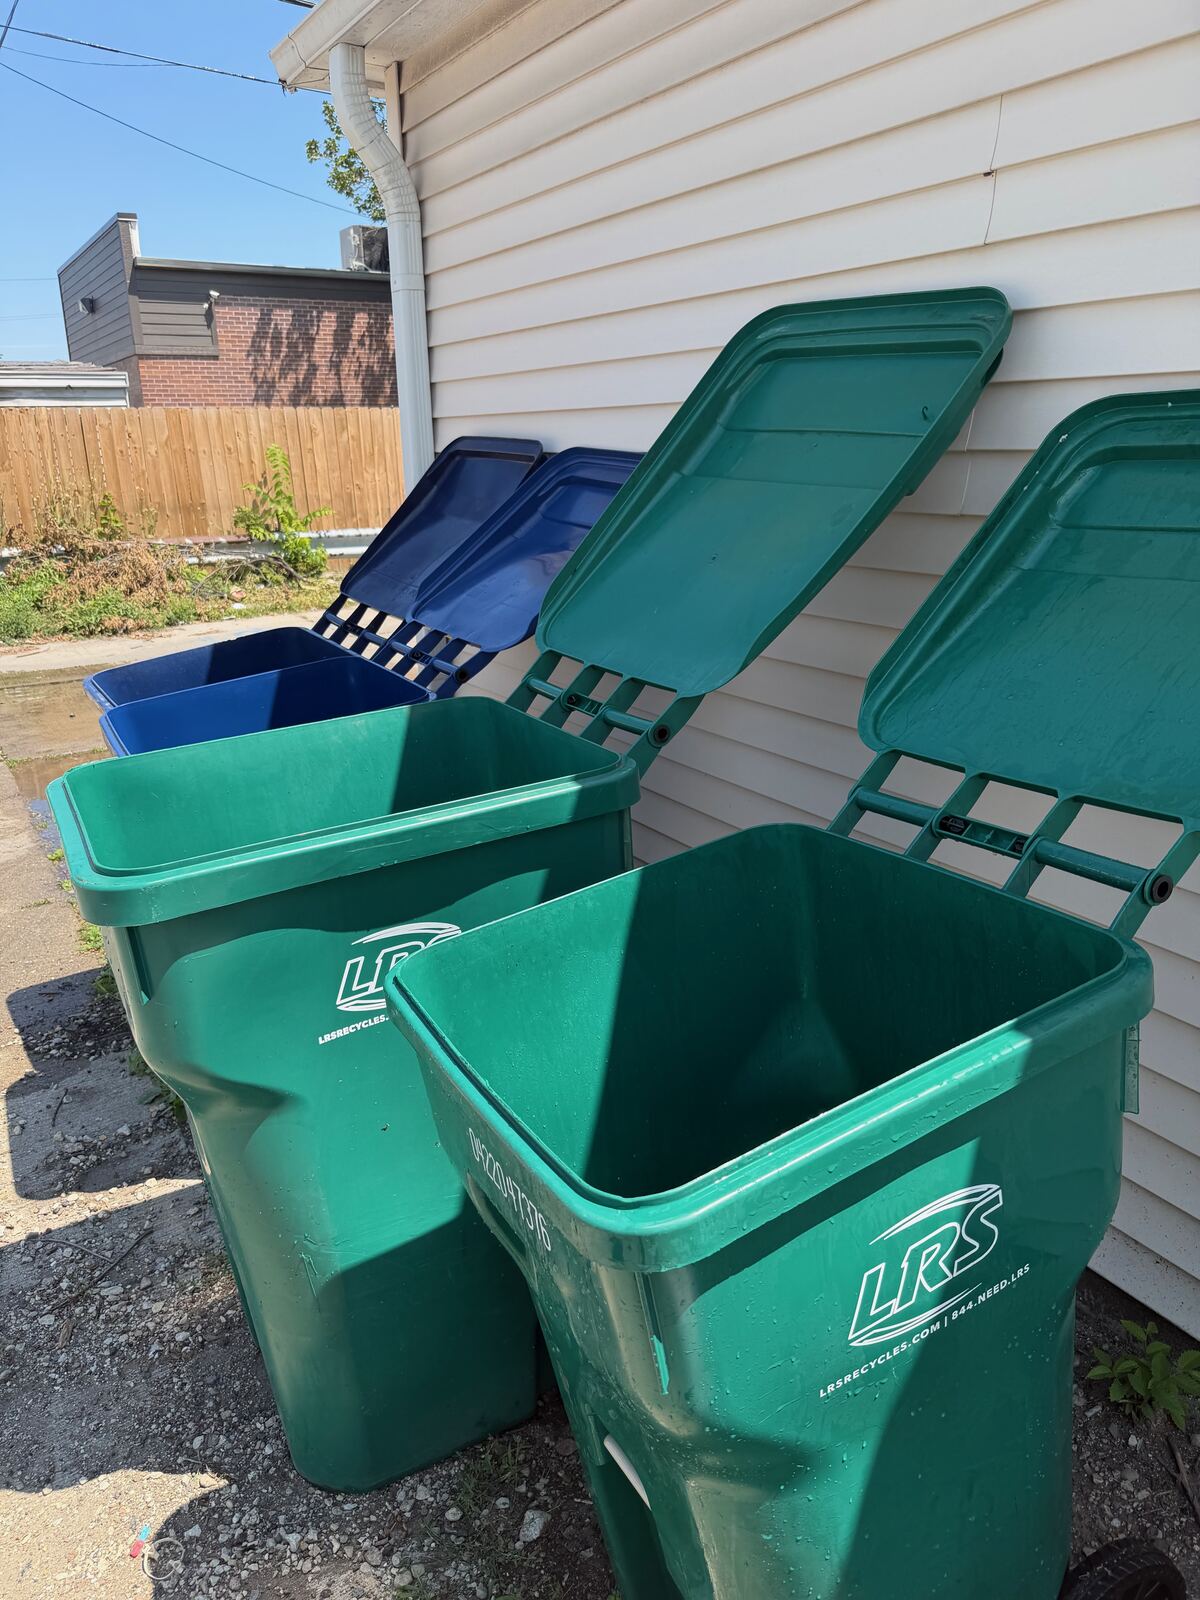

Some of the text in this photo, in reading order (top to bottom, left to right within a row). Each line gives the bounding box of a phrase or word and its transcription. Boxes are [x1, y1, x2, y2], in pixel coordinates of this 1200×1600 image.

[318, 1014, 389, 1045] LRSRECYCLES.
[336, 929, 462, 1005] LR
[468, 1127, 552, 1252] 0422047376
[847, 1187, 1004, 1341] LRS
[819, 1321, 941, 1398] LRSRECYCLES.COM
[951, 1263, 1031, 1321] 844.NEED.LRS
